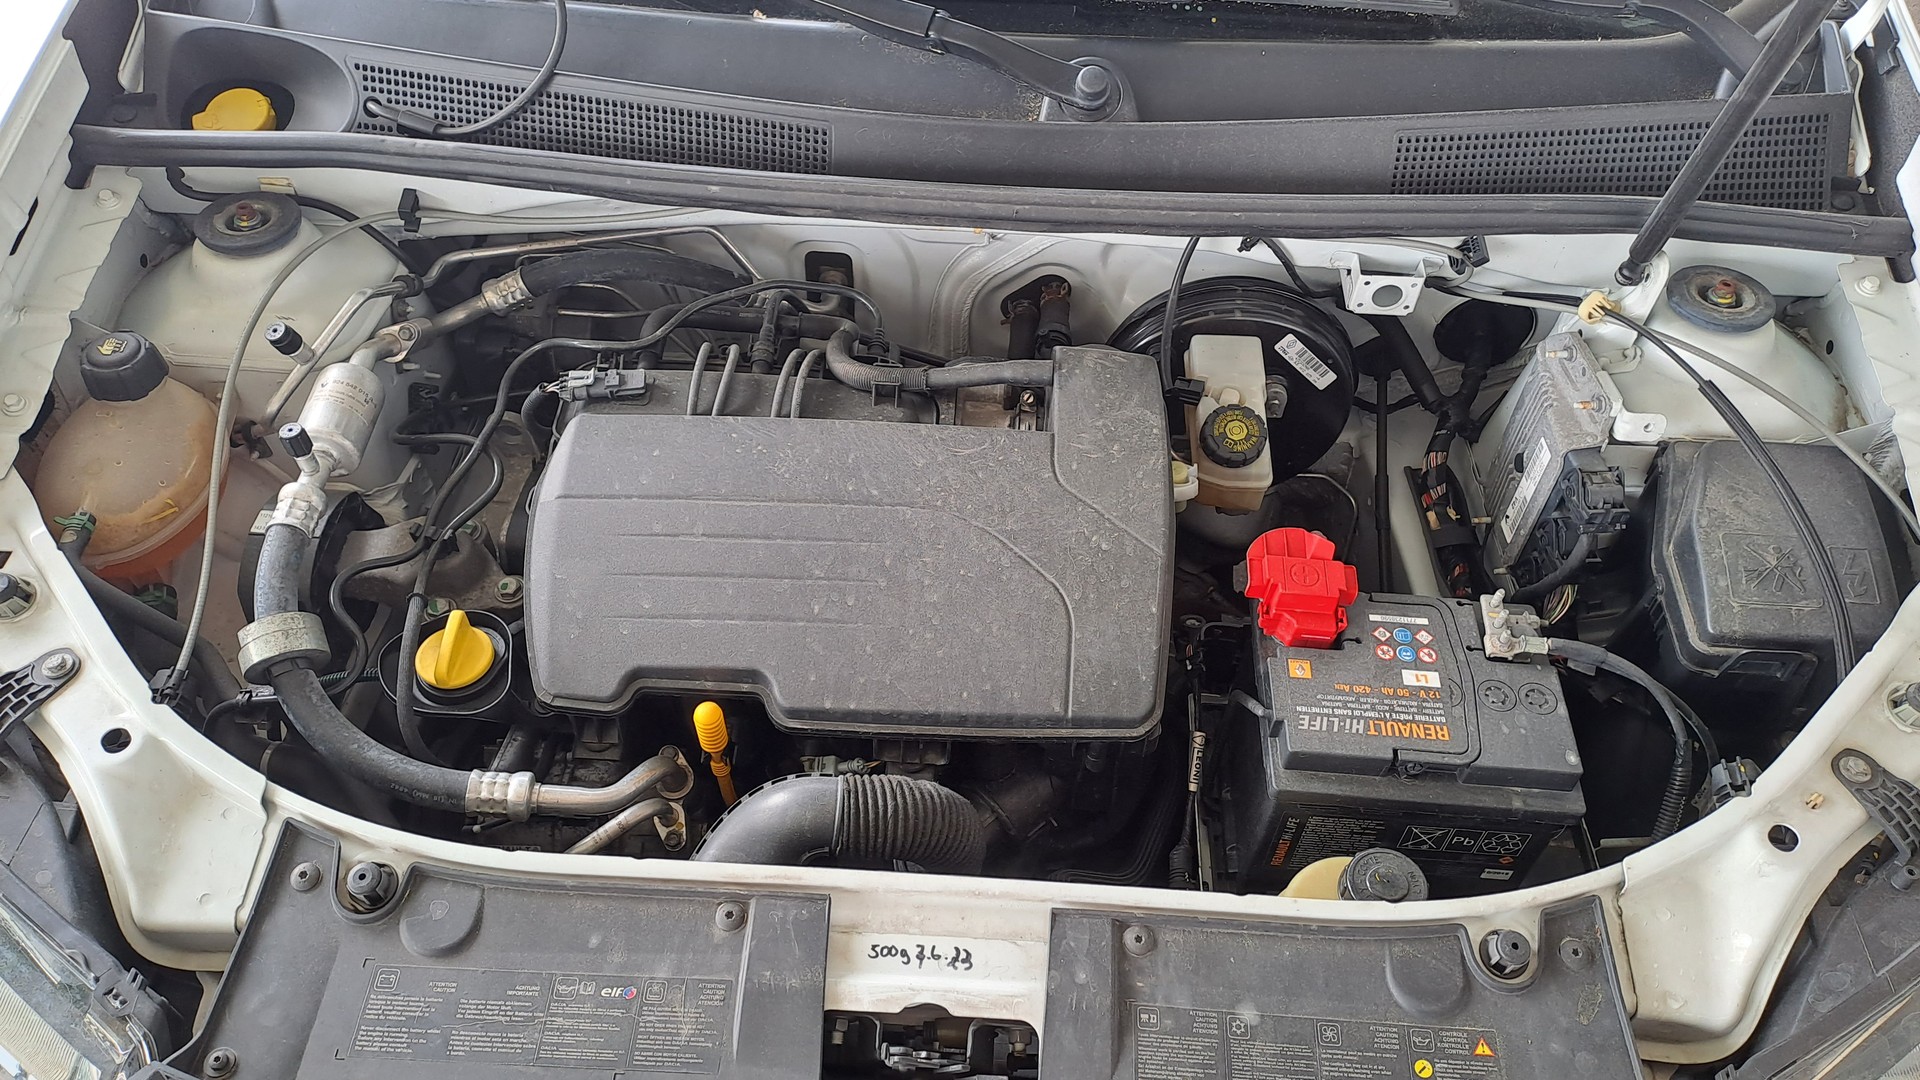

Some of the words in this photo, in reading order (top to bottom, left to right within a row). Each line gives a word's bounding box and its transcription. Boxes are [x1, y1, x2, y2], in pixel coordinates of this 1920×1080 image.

[1414, 673, 1429, 684] L1
[1353, 685, 1371, 694] 420
[1381, 687, 1394, 695] Ah
[1397, 688, 1410, 696] 50
[1419, 689, 1427, 698] V
[1428, 690, 1441, 699] 12
[1296, 705, 1332, 714] ENTRETIEN
[1333, 708, 1352, 716] SANS
[1353, 710, 1384, 718] L'EMPLOI
[1391, 712, 1413, 721] PRÊTE
[1414, 714, 1446, 722] BATTERIE
[1367, 720, 1450, 741] RENAULT
[1193, 750, 1204, 781] LEONI
[1452, 836, 1474, 846] Pb
[1271, 838, 1290, 866] RENAULT
[867, 944, 911, 965] 500g
[600, 987, 624, 997] elf
